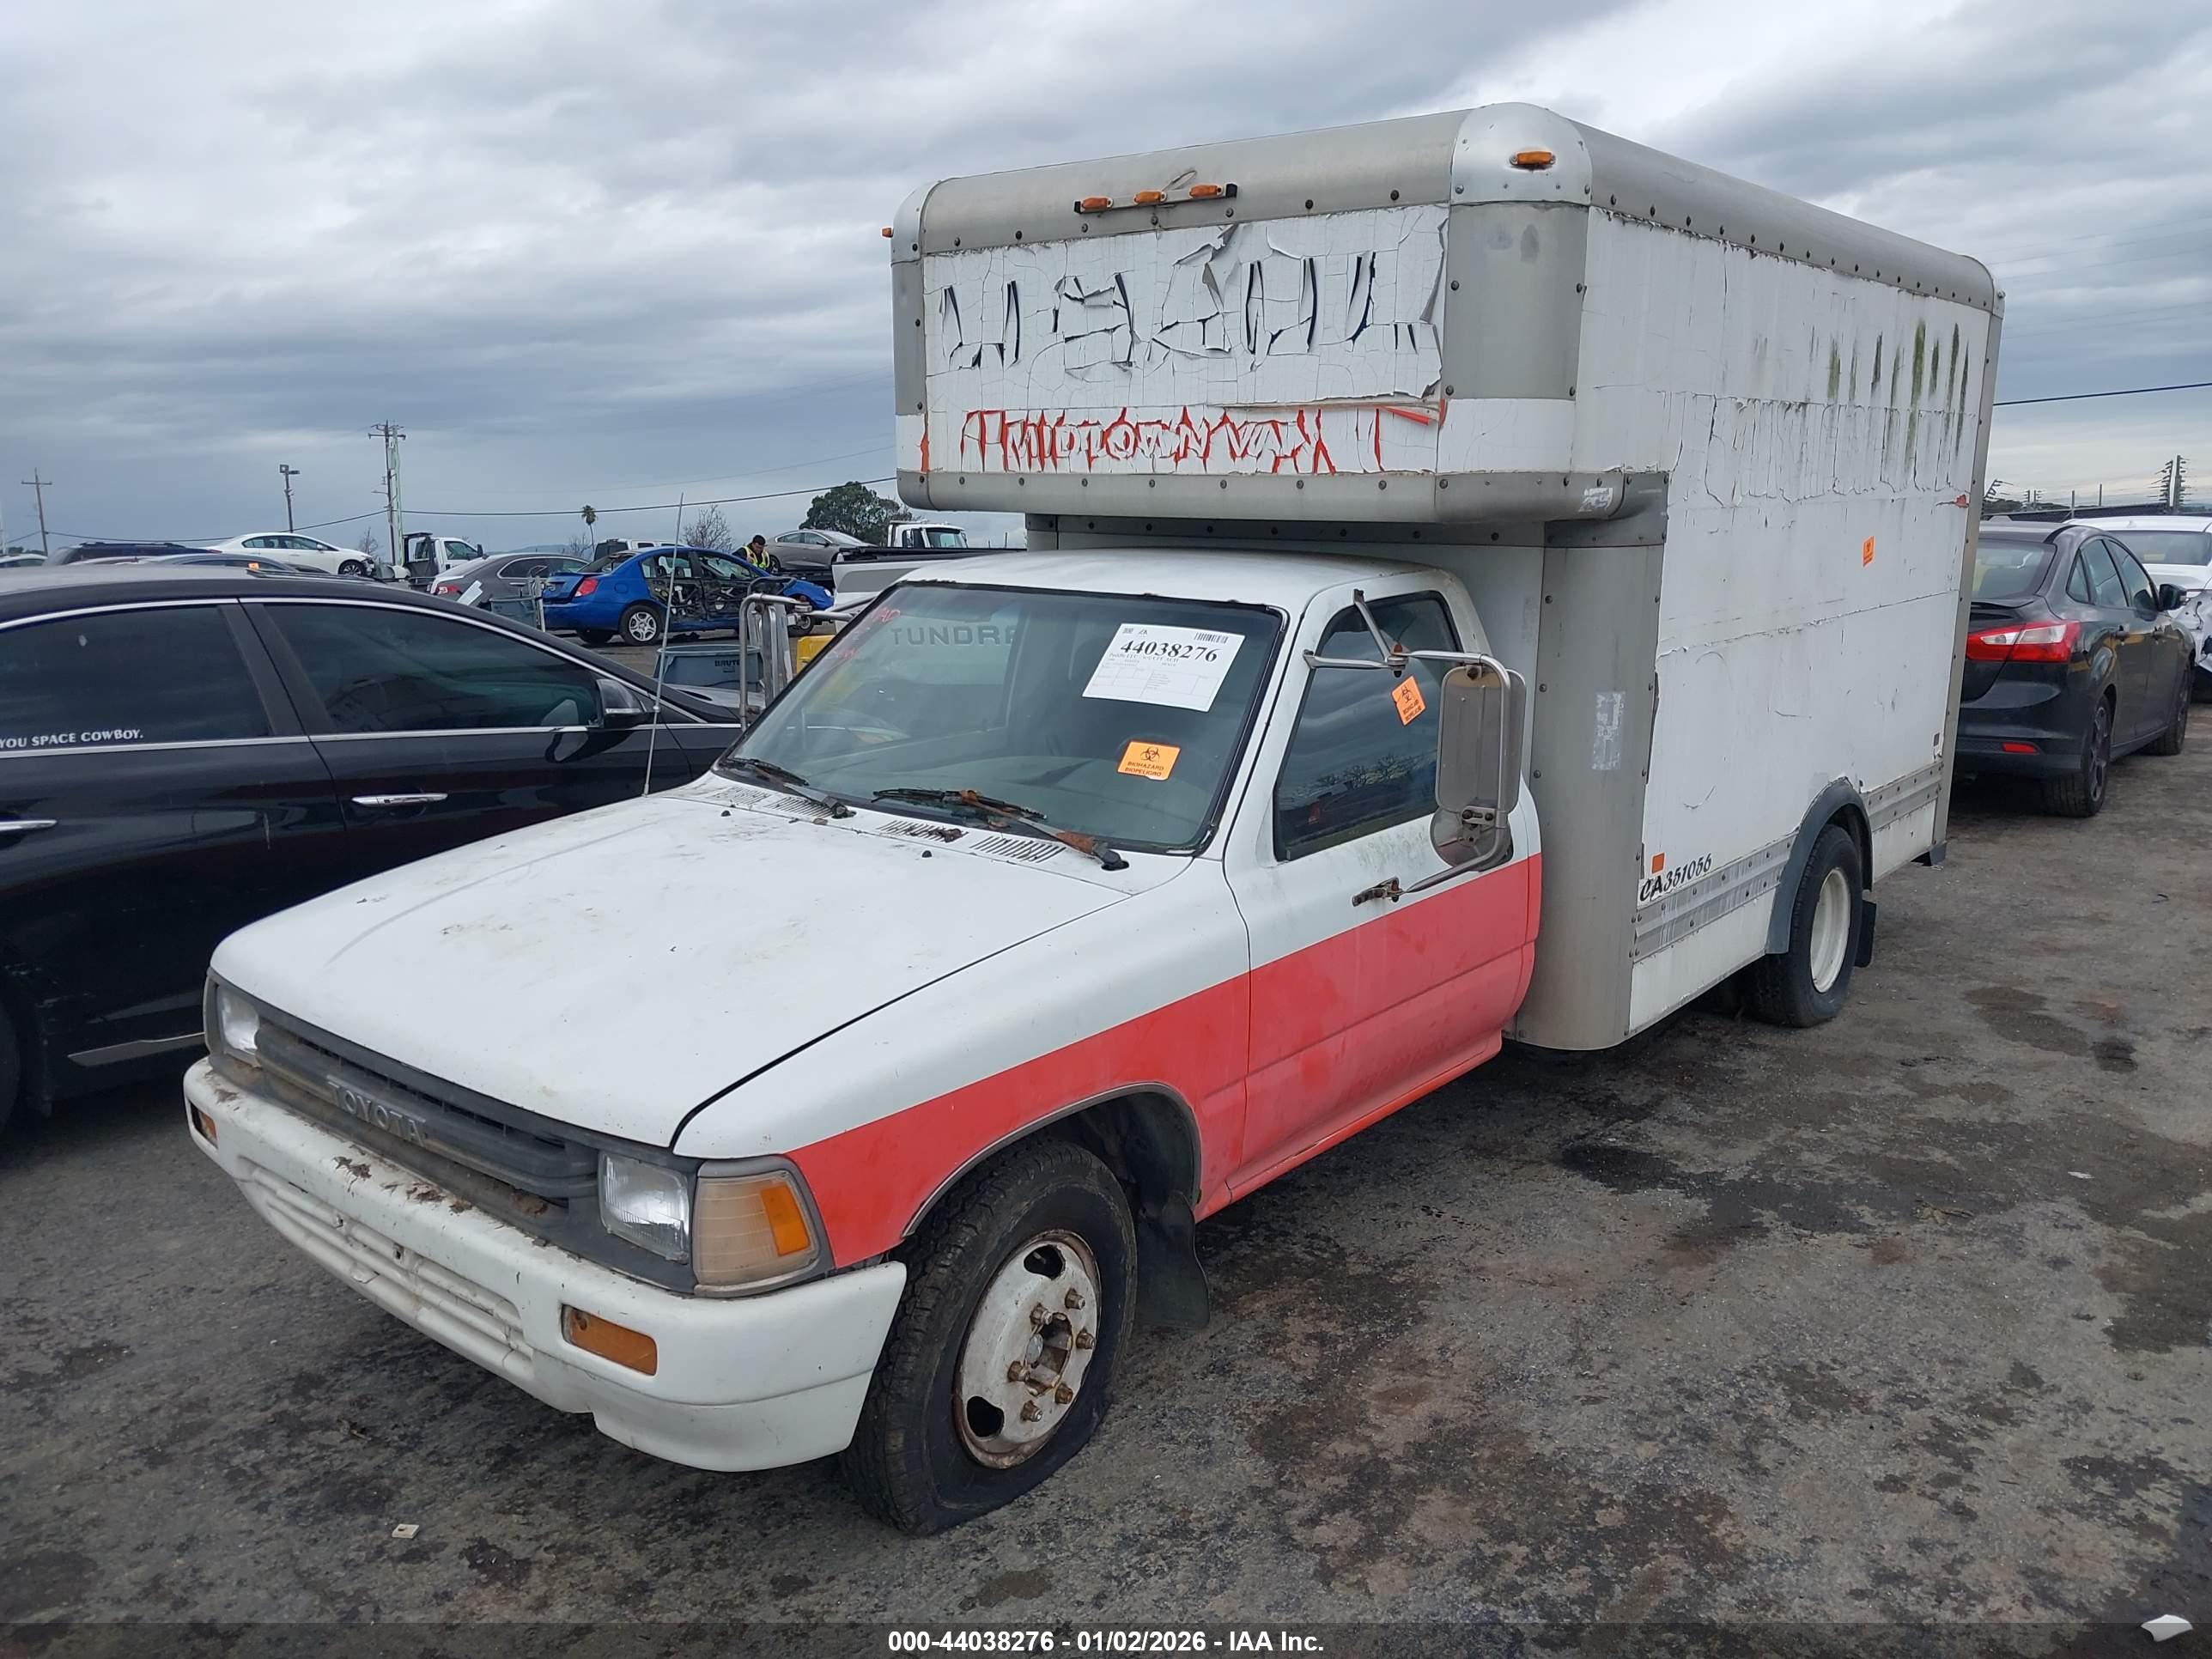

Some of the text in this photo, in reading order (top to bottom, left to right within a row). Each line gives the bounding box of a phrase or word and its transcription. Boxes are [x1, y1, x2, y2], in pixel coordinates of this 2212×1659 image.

[1120, 640, 1223, 663] 44038276
[0, 728, 144, 749] YOU SPACE COWBOY.
[1127, 761, 1164, 771] BIOHAZARD
[1639, 853, 1711, 902] CA351056
[326, 1076, 428, 1147] TOYOTA
